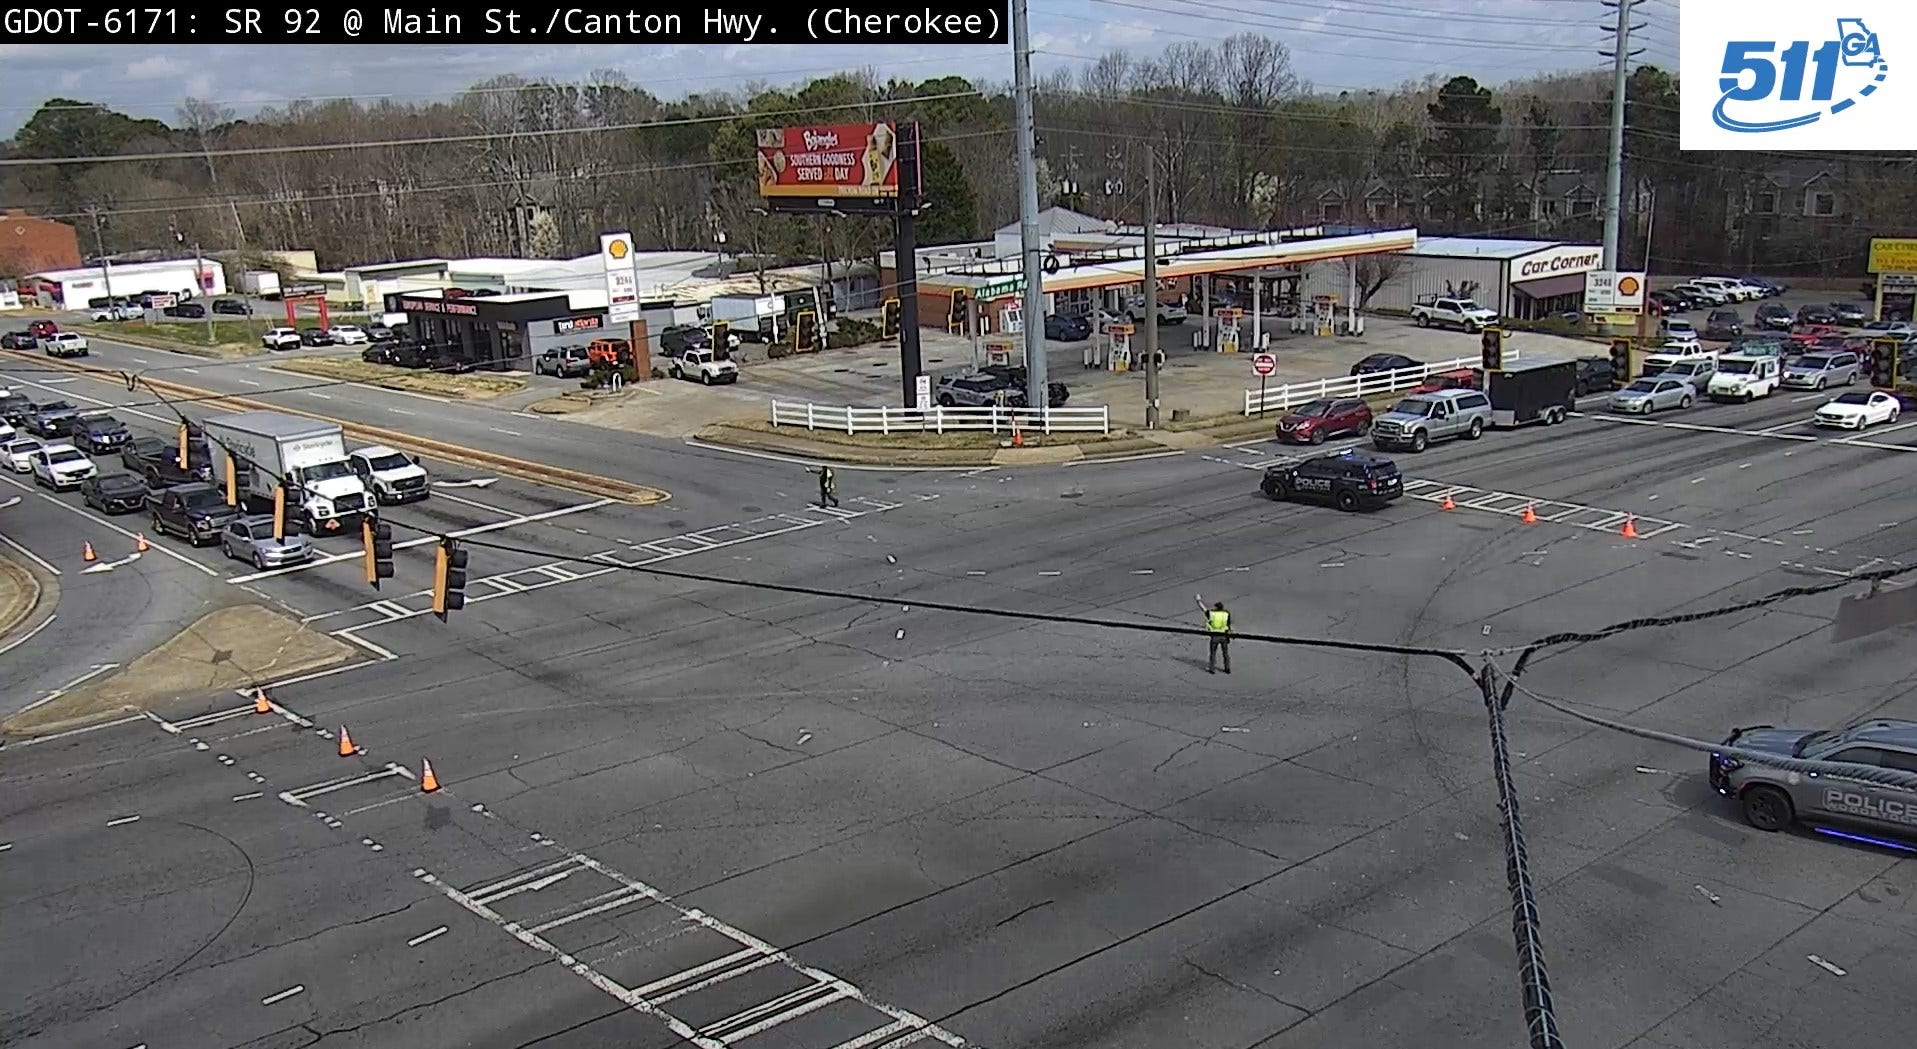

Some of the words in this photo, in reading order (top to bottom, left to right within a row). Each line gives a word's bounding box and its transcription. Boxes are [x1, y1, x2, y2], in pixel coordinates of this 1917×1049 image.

[790, 153, 822, 167] SOUTHERN
[822, 152, 856, 166] GOODNESS
[797, 167, 823, 181] SERVED
[834, 167, 850, 180] DAY
[1521, 260, 1549, 276] Car
[1550, 252, 1599, 271] Corner
[975, 284, 1014, 299] Alabama
[1016, 279, 1028, 290] Rd
[1296, 477, 1331, 487] POLICE
[1827, 790, 1917, 818] POLICE
